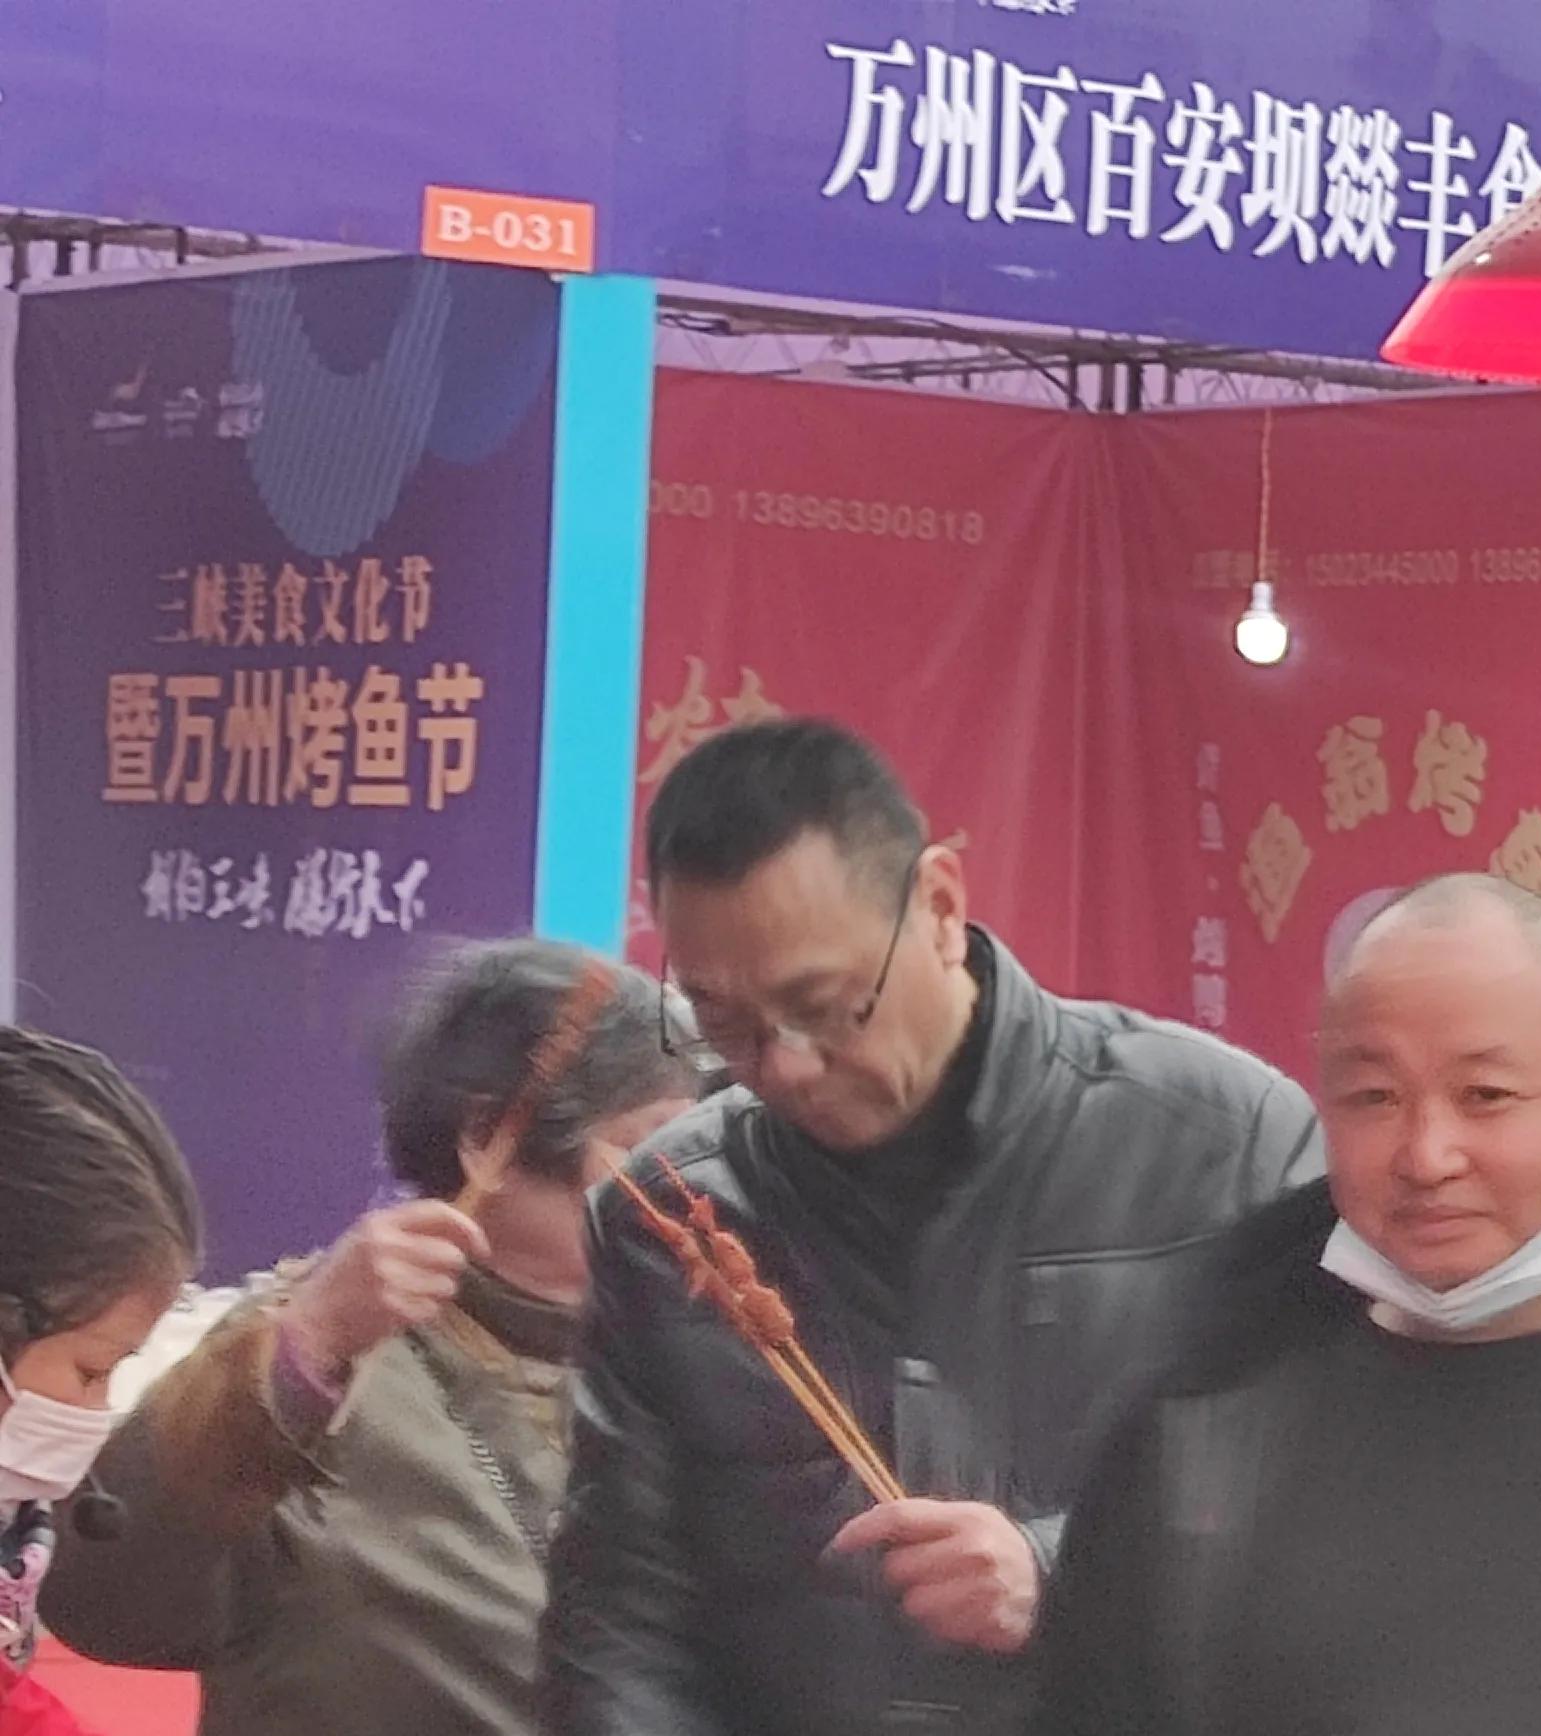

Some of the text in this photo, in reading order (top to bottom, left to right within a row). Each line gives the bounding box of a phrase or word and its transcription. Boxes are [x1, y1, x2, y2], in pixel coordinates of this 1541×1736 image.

[438, 206, 577, 256] B-031
[155, 555, 433, 647] 三峡美食文化节
[102, 662, 484, 811] 暨万州烤鱼节
